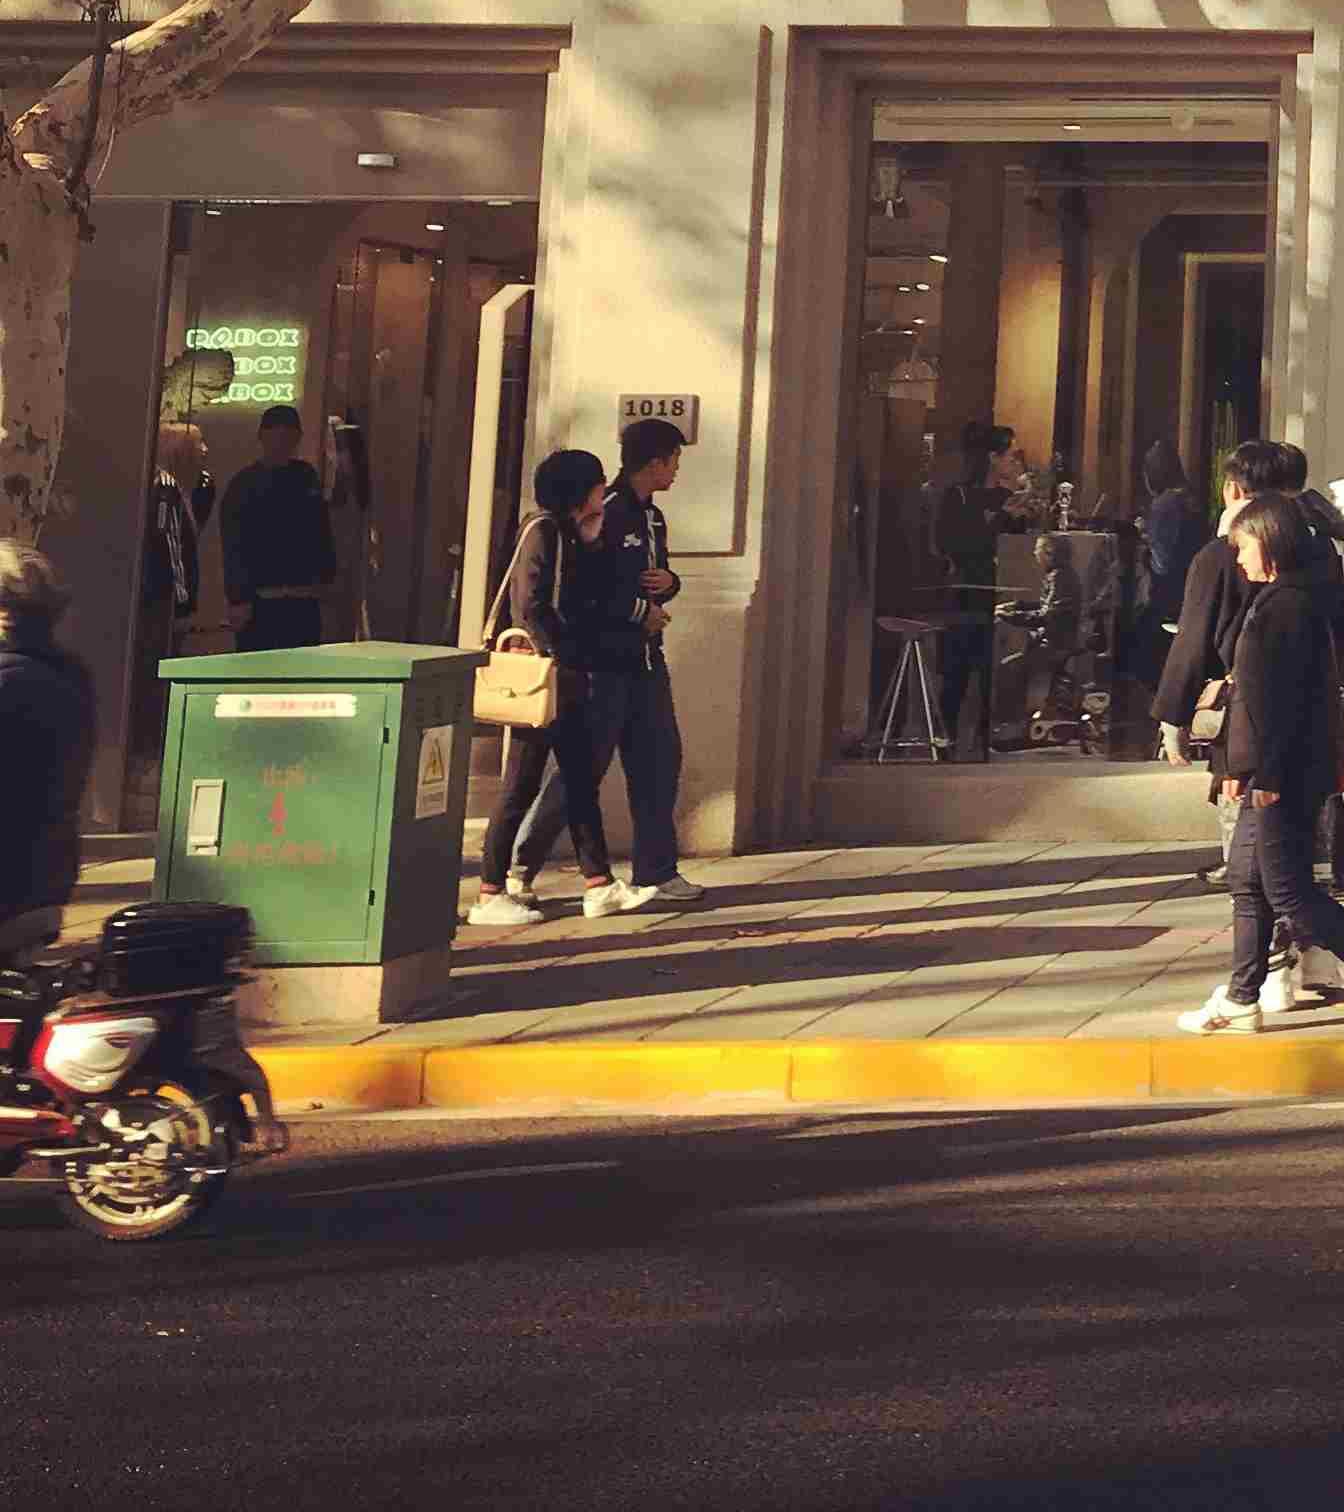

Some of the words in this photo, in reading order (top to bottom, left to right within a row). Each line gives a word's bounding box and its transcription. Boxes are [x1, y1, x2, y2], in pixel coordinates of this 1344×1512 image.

[231, 355, 296, 375] BOX
[209, 382, 294, 403] BOX
[625, 399, 685, 417] 1018
